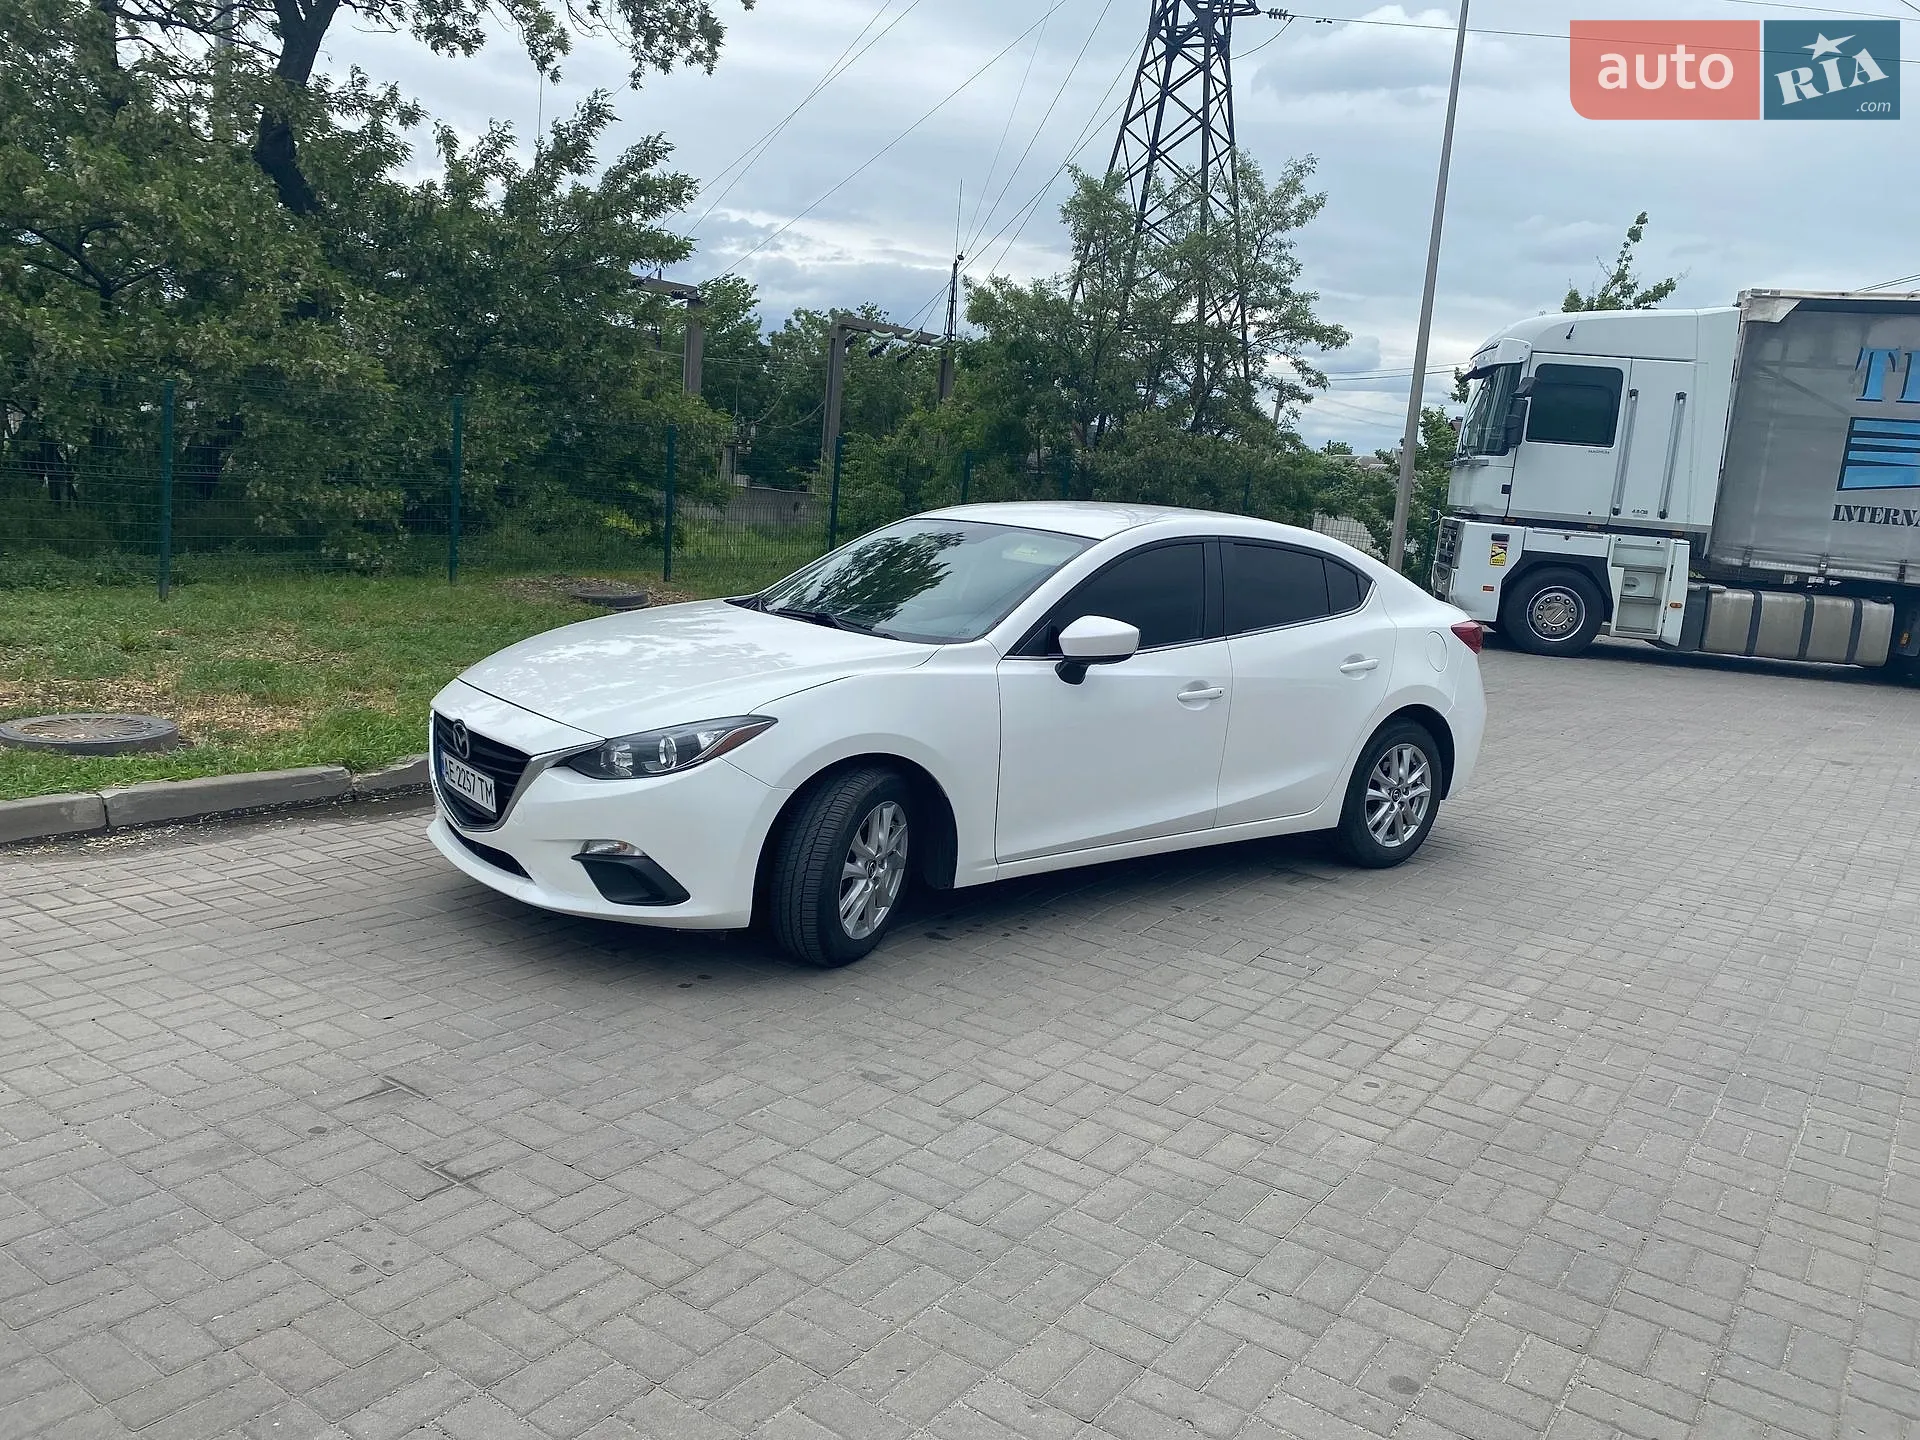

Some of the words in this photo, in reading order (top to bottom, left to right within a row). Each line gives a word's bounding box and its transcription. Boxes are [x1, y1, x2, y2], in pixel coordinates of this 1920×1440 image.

[445, 757, 456, 784] AE
[456, 766, 476, 796] 2257
[478, 777, 494, 807] TM
